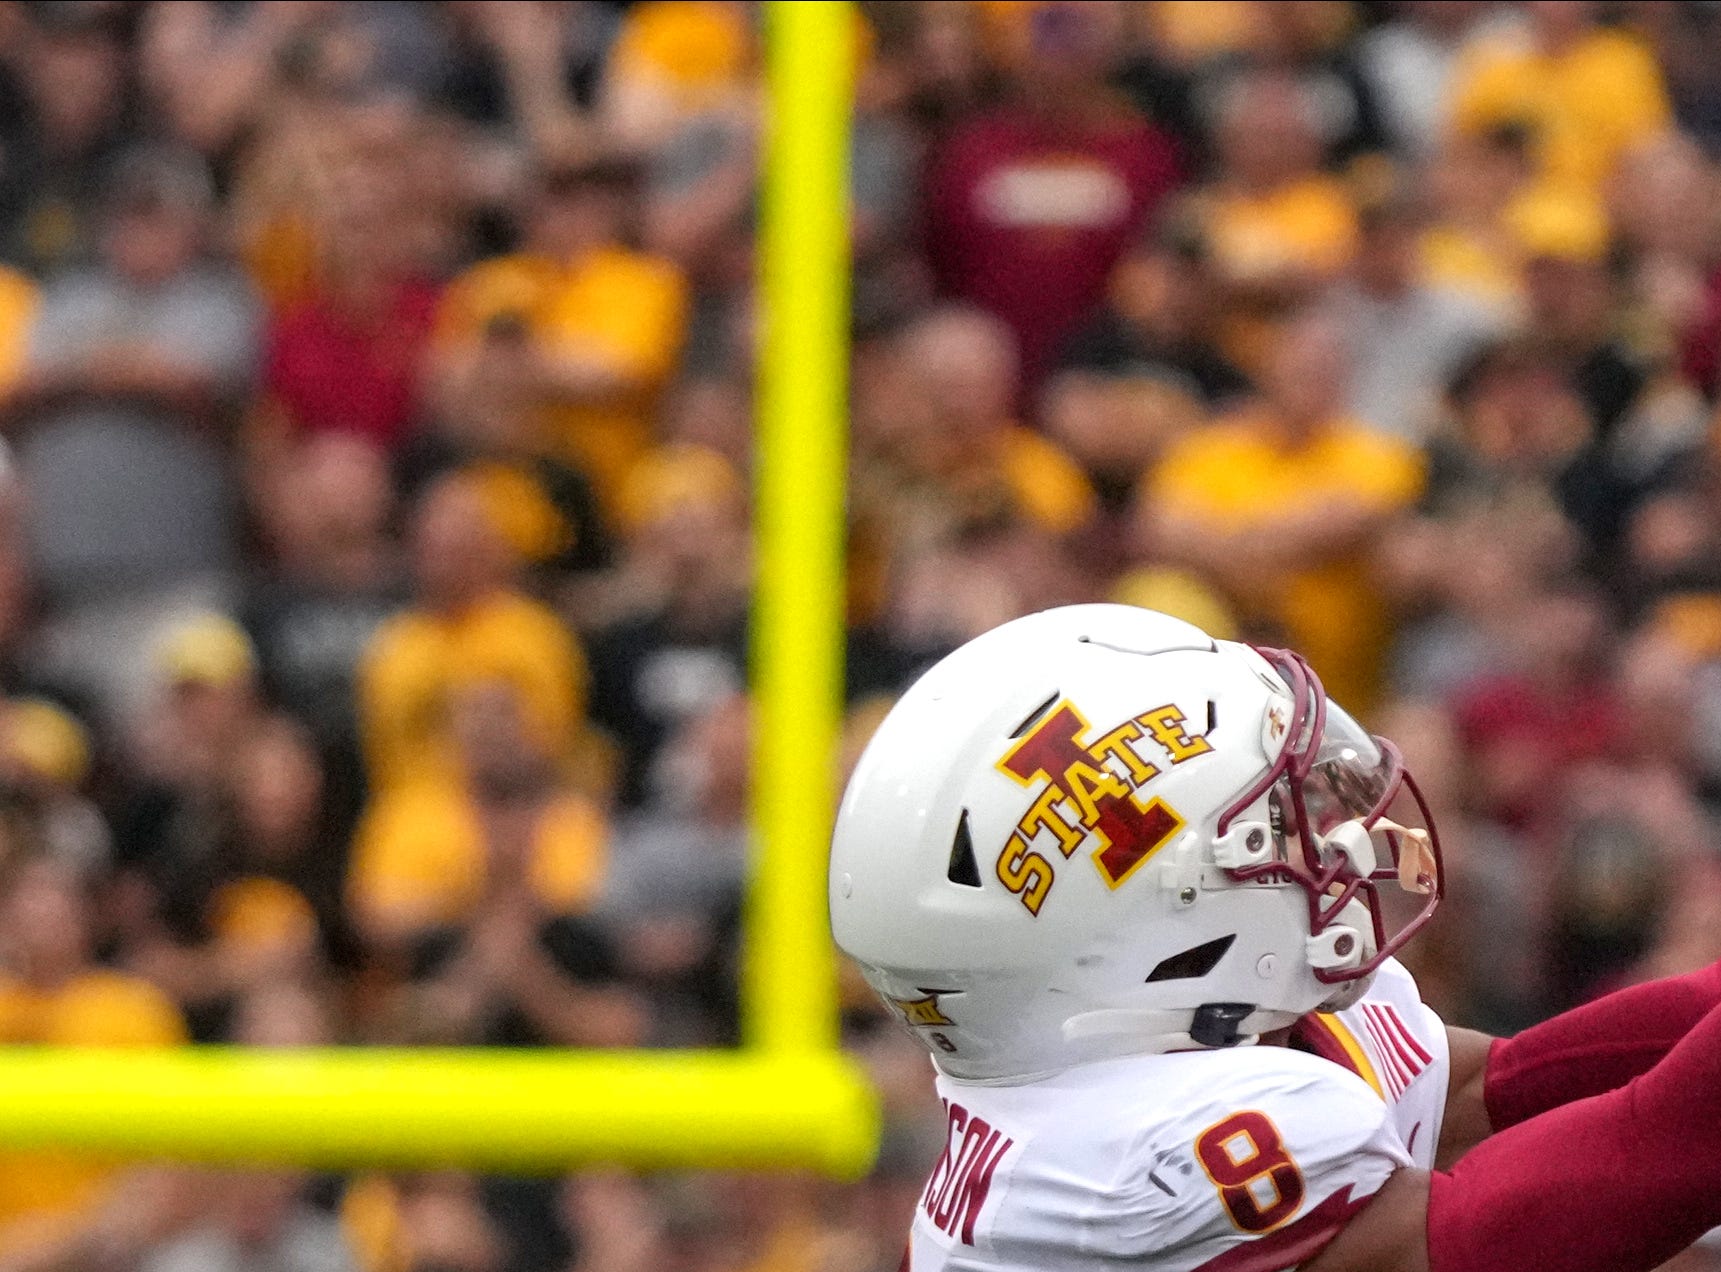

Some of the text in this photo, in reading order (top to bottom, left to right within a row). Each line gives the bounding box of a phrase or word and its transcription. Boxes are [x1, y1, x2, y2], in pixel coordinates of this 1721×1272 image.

[995, 703, 1216, 918] STATE
[924, 1097, 1014, 1247] SON
[1193, 1109, 1307, 1235] 8
